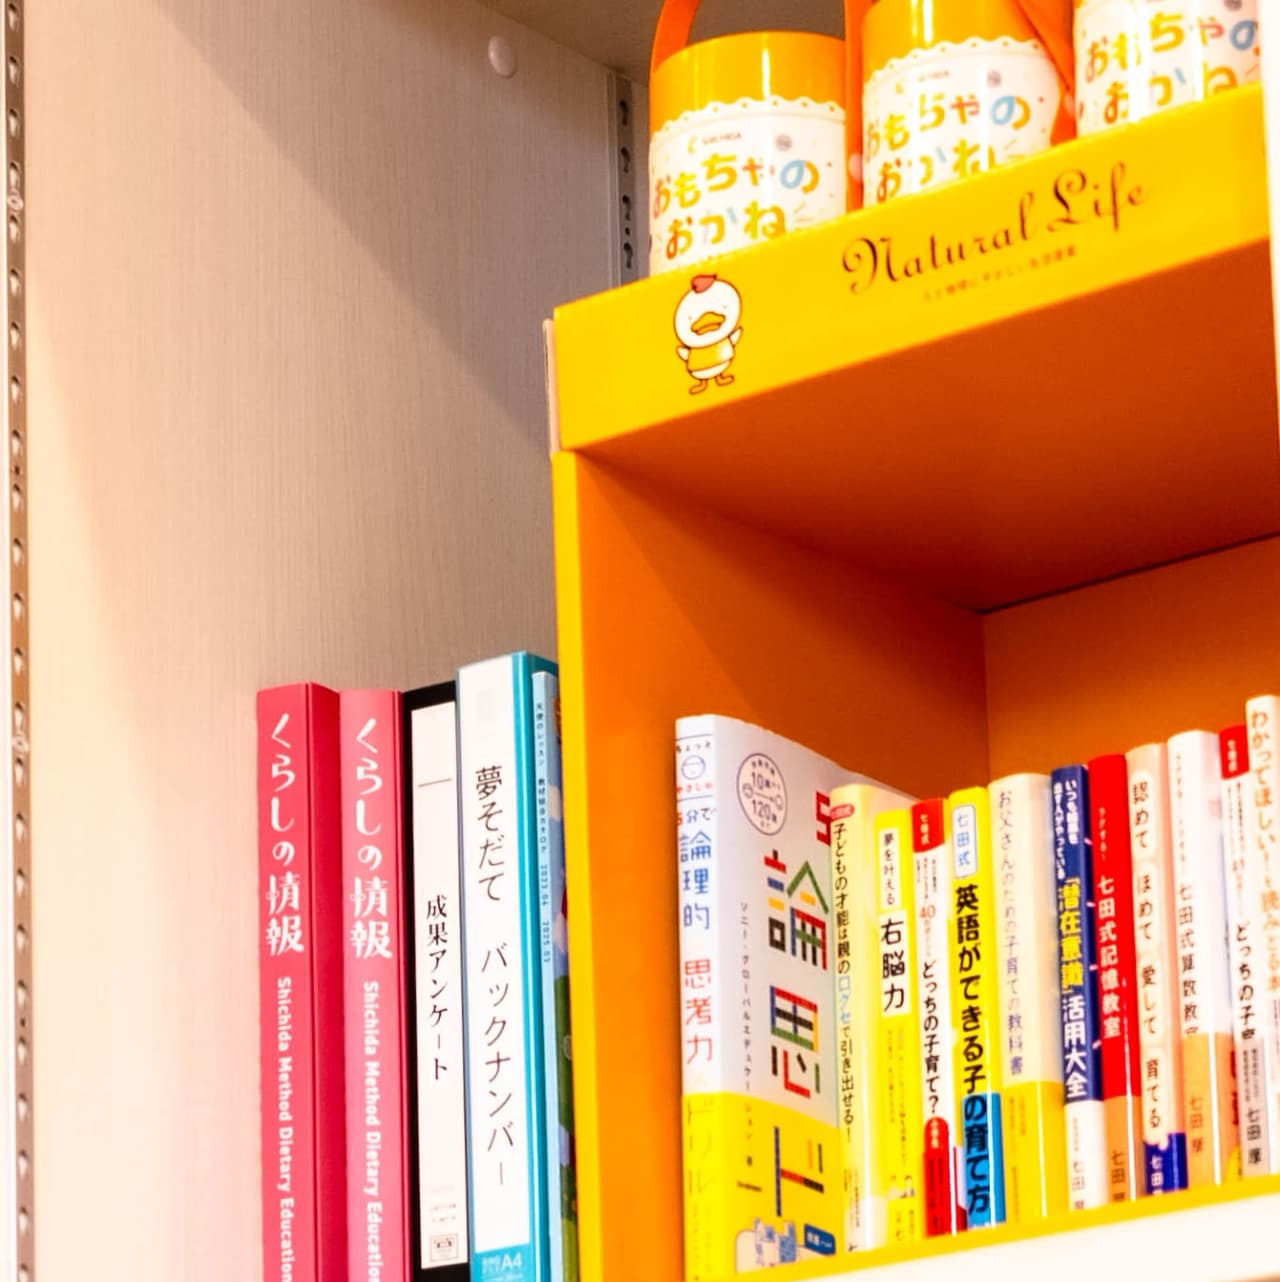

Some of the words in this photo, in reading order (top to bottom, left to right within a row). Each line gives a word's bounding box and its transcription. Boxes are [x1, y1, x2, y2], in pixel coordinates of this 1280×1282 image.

[842, 191, 1035, 296] Natural
[1046, 161, 1147, 233] Life
[265, 712, 305, 957] くらしの情報
[349, 716, 393, 960] くらしの情報
[474, 765, 506, 902] 夢そだて
[680, 830, 713, 931] 論理的
[957, 813, 971, 867] 七田式
[1138, 874, 1154, 941] ほめて
[426, 894, 449, 1082] 成果アンケート
[881, 917, 906, 1012] 右脳力
[1098, 875, 1122, 1039] 七田式記憶教室
[1142, 964, 1156, 1035] 愛して
[276, 976, 293, 1053] Shichida
[364, 980, 381, 1056] Shichida
[684, 958, 714, 1066] 思考力
[922, 959, 940, 1114] どっちの子育て?
[955, 883, 991, 1215] 英語ができる子の育て方
[278, 1056, 293, 1122] Method
[364, 1061, 381, 1127] Method
[481, 942, 515, 1187] バックナンバー
[1146, 1058, 1162, 1129] 育てる
[276, 1127, 293, 1194] Dietary
[363, 1131, 382, 1198] Dietary
